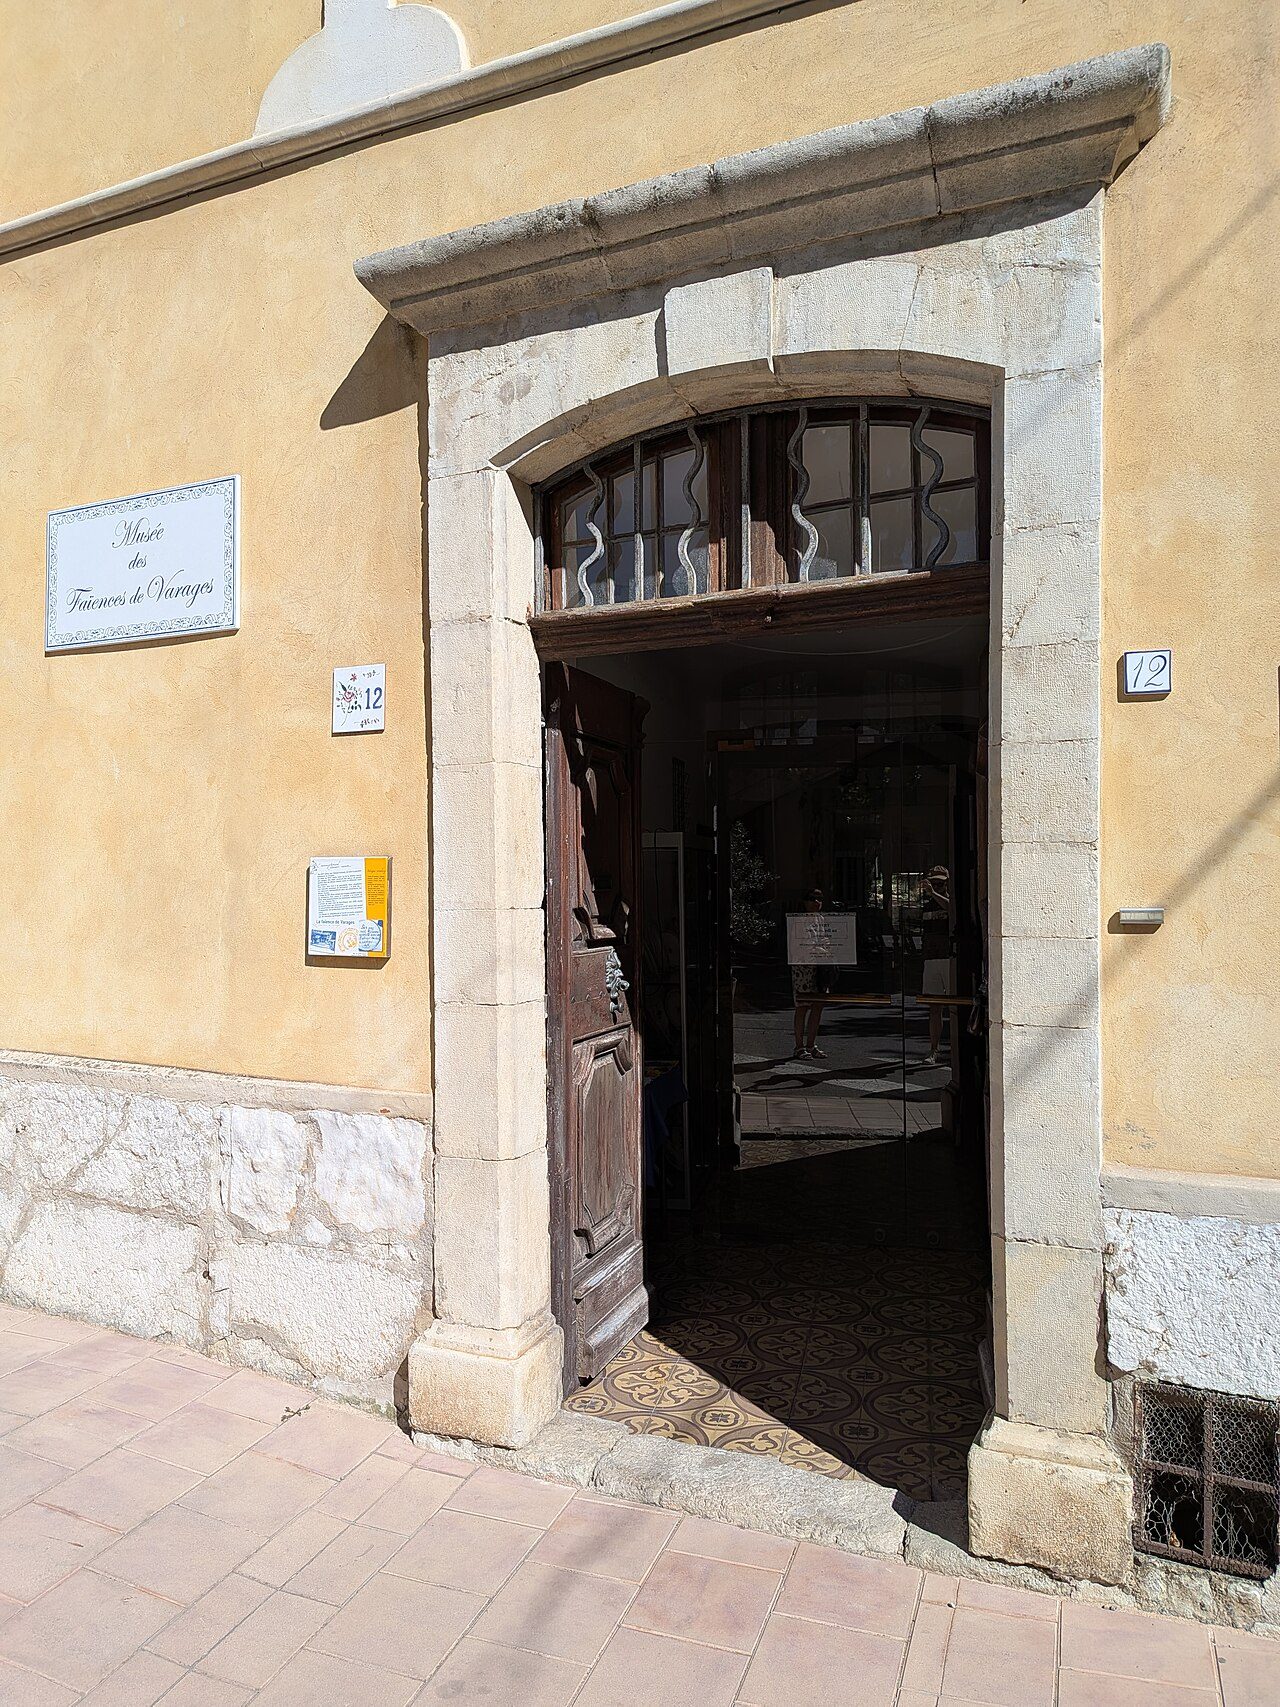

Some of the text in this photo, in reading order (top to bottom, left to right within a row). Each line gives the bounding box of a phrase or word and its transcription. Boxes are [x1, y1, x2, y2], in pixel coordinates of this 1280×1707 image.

[112, 517, 164, 548] Musée
[128, 552, 147, 570] des
[129, 586, 144, 604] de
[147, 569, 214, 608] Varages
[1133, 655, 1167, 688] 12
[365, 687, 382, 710] 12
